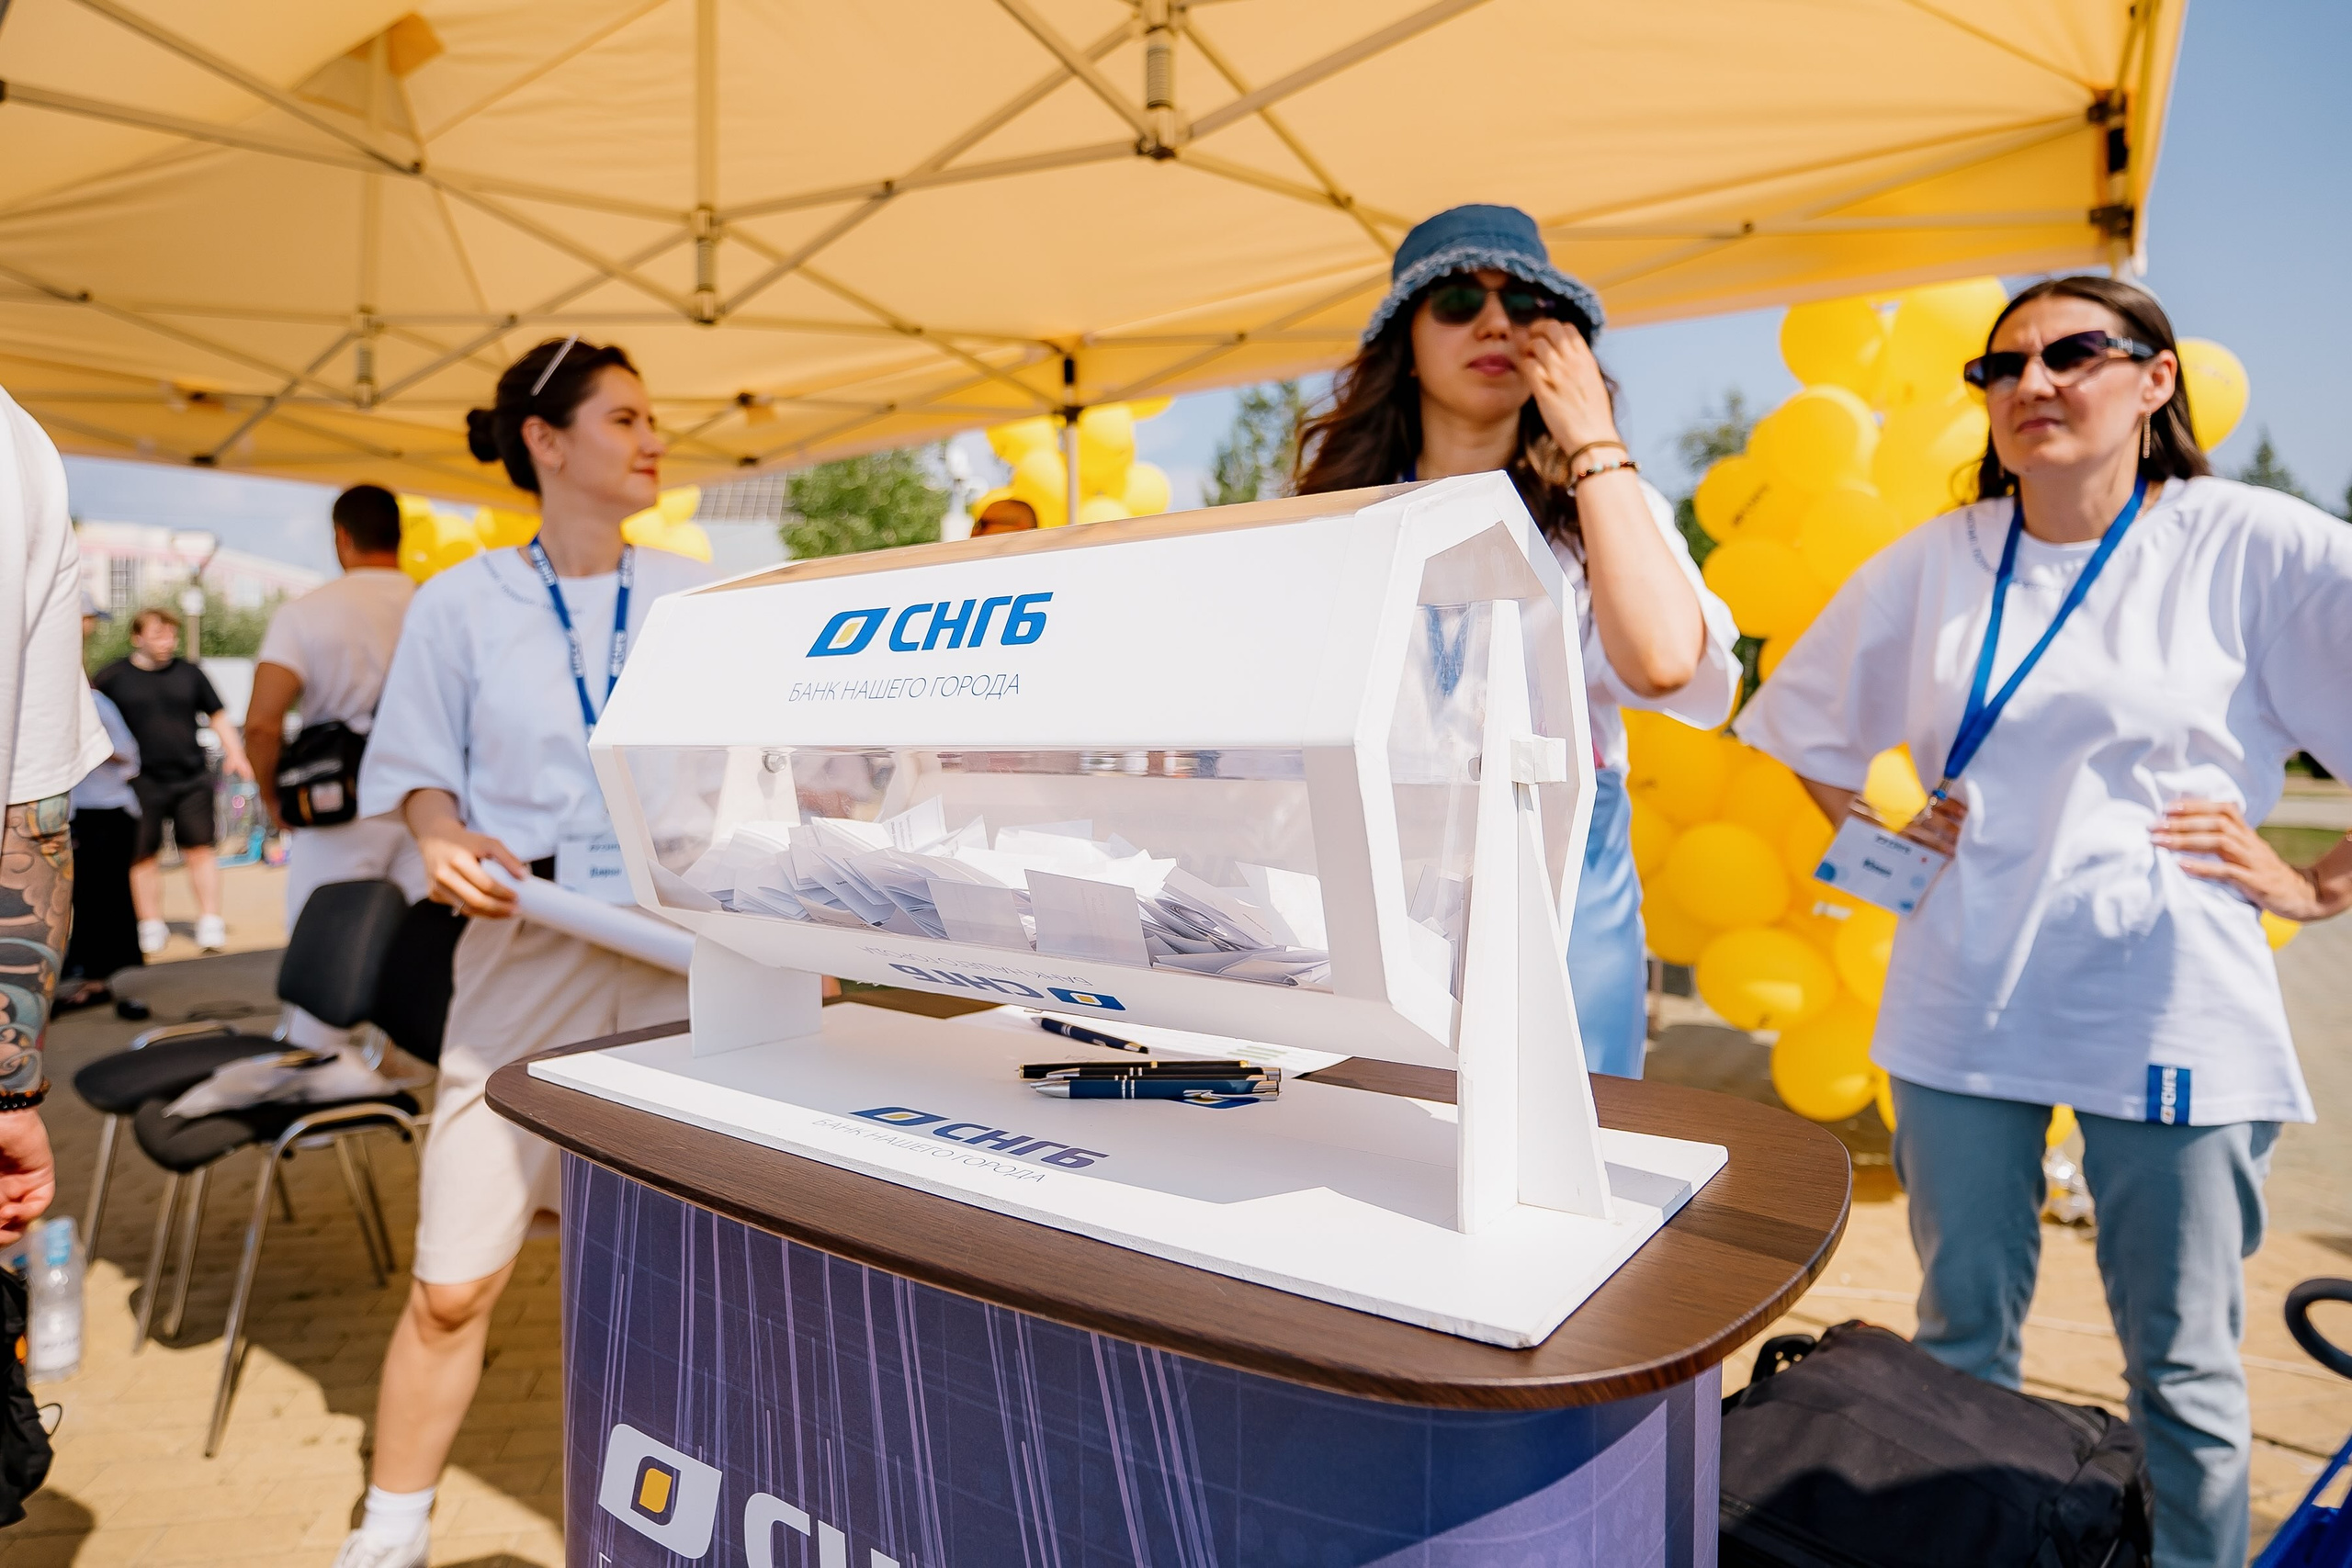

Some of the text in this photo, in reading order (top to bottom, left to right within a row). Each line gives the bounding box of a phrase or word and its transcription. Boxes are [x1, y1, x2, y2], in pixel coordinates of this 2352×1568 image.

[888, 591, 1055, 653] СНГБ
[787, 673, 1020, 702] БАНК НАШЕГО ГОРОДА
[888, 962, 1046, 998] СНГБ
[811, 1118, 1046, 1183] БАНК НАШЕГО ГОРОДА
[932, 1122, 1111, 1169] СНГБ
